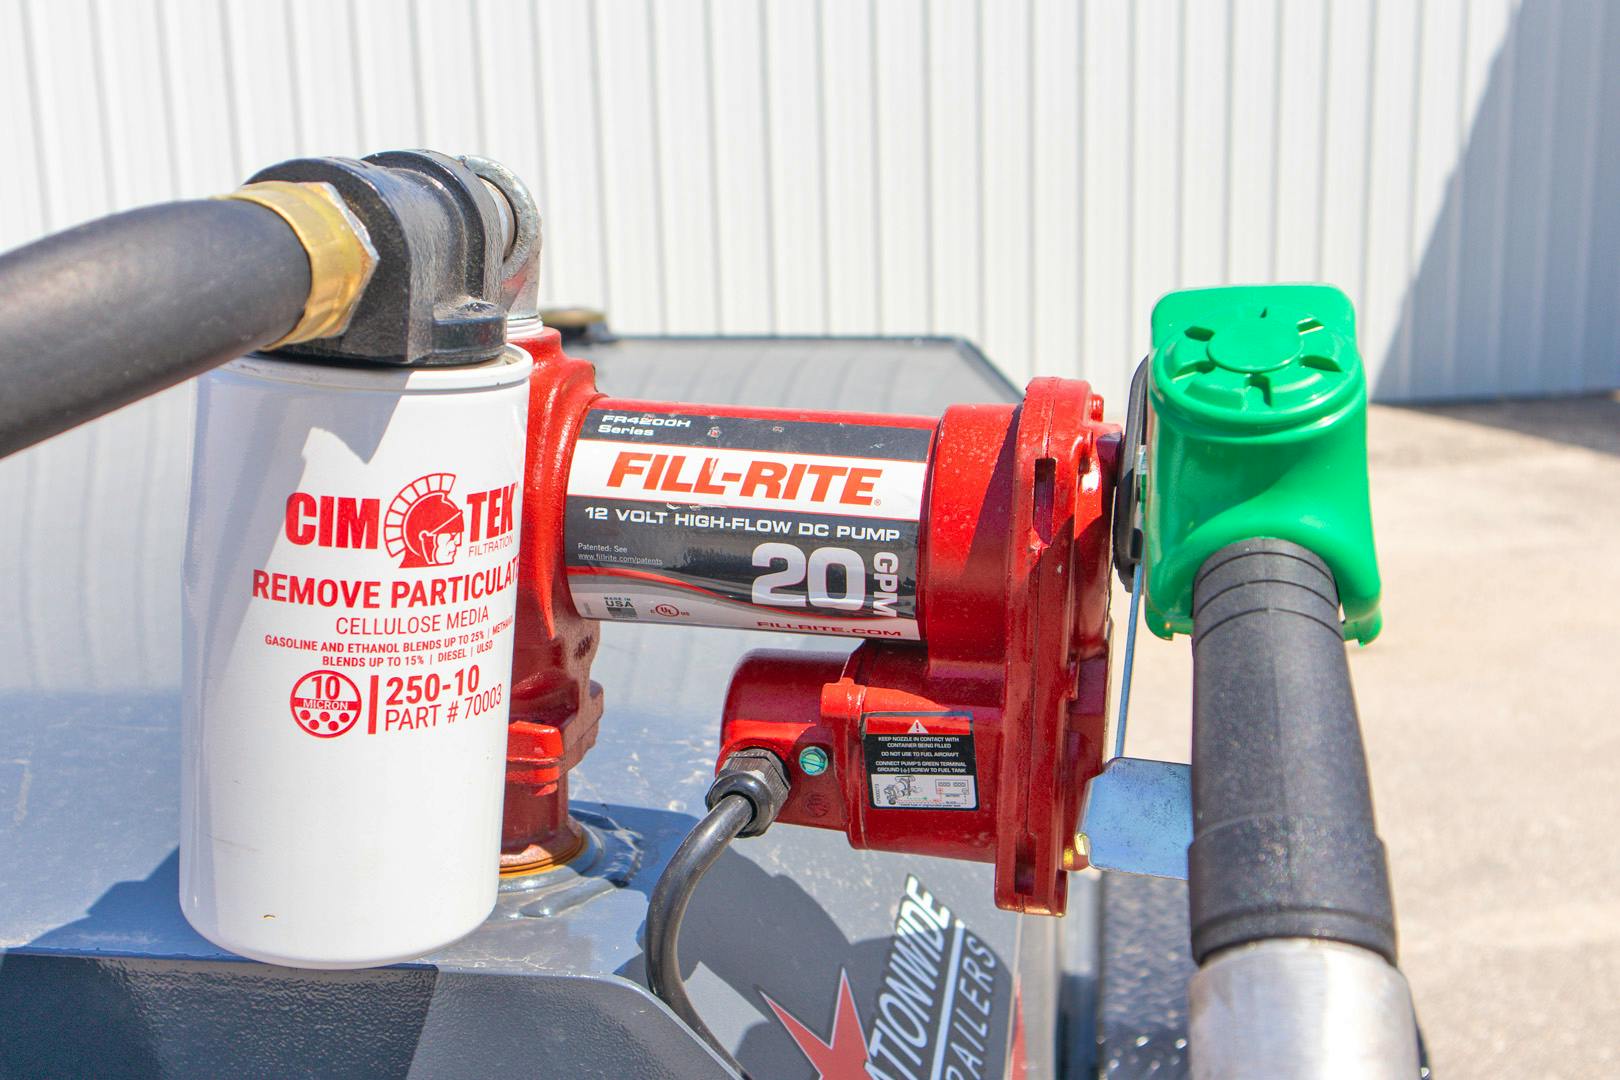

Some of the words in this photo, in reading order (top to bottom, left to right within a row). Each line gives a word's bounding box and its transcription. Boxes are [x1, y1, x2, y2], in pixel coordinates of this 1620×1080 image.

[598, 424, 654, 436] Series
[601, 414, 691, 428] FR4200H
[606, 451, 882, 506] FILL-RITE
[285, 492, 380, 550] CIM
[466, 482, 516, 543] TEK
[584, 506, 608, 520] 12
[615, 508, 668, 524] VOLT
[675, 512, 792, 535] HIGH-FLOW
[798, 522, 829, 537] DC
[836, 525, 900, 542] PUMP
[468, 534, 514, 558] FILTRATION
[578, 542, 612, 552] Patented:
[614, 545, 627, 553] See
[253, 569, 380, 609] REMOVE
[752, 542, 866, 611] 20
[873, 551, 899, 617] GPM
[605, 600, 633, 608] USA
[336, 614, 441, 635] CELLULOSE
[446, 605, 489, 630] MEDIA
[757, 621, 901, 636] FILLRITE.COM
[265, 634, 318, 651] GASOLINE
[321, 641, 344, 653] AND
[348, 643, 399, 653] ETHANOL
[403, 640, 441, 652] BLENDS
[444, 637, 455, 648] UP
[459, 634, 469, 645] TO
[471, 631, 484, 643] 25%
[322, 656, 365, 667] BLENDS
[369, 657, 384, 667] UP
[387, 657, 401, 667] TO
[405, 656, 424, 665] 15%
[438, 648, 467, 662] DIESEL
[477, 640, 493, 654] ULSD
[311, 675, 341, 700] 10
[386, 664, 480, 705] 250-10
[303, 699, 349, 710] MICRON
[385, 704, 441, 731] PART
[447, 700, 459, 723] #
[464, 683, 502, 719] 70003
